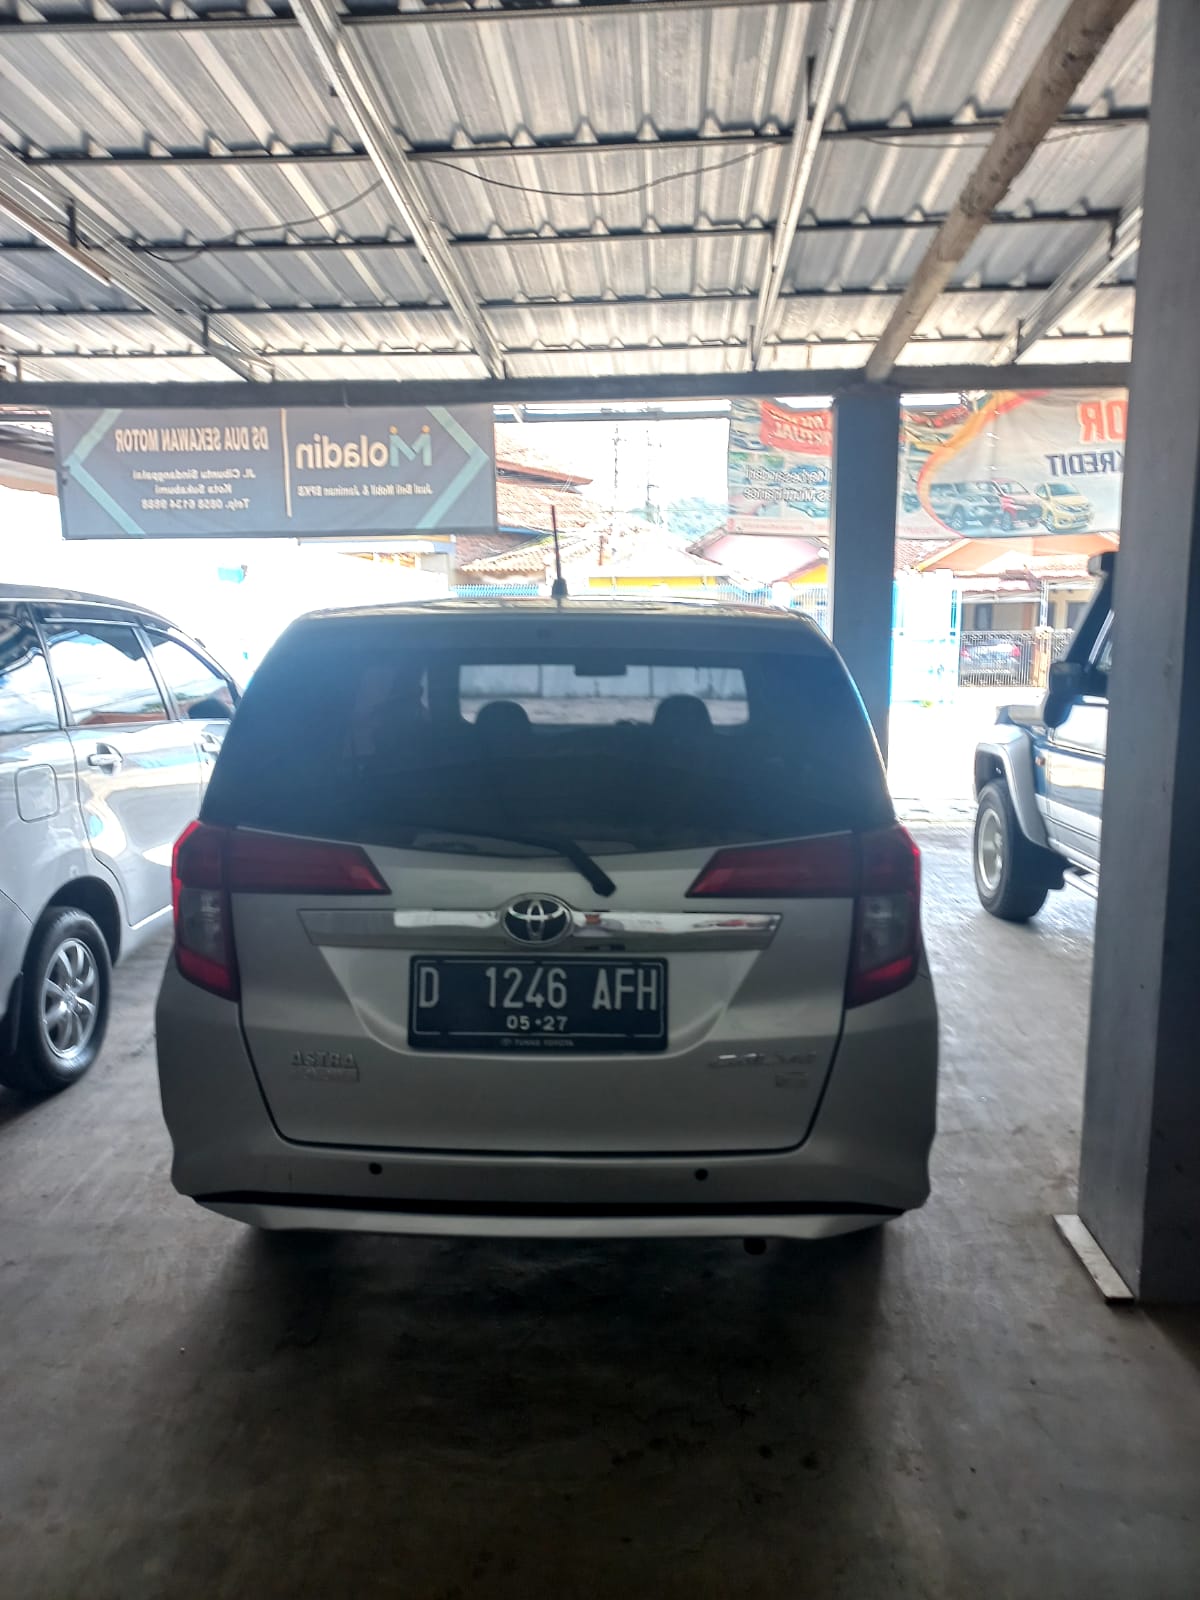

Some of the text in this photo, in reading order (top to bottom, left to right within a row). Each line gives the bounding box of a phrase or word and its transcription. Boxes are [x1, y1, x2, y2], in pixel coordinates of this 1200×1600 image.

[418, 966, 658, 1012] D 1246 AFH
